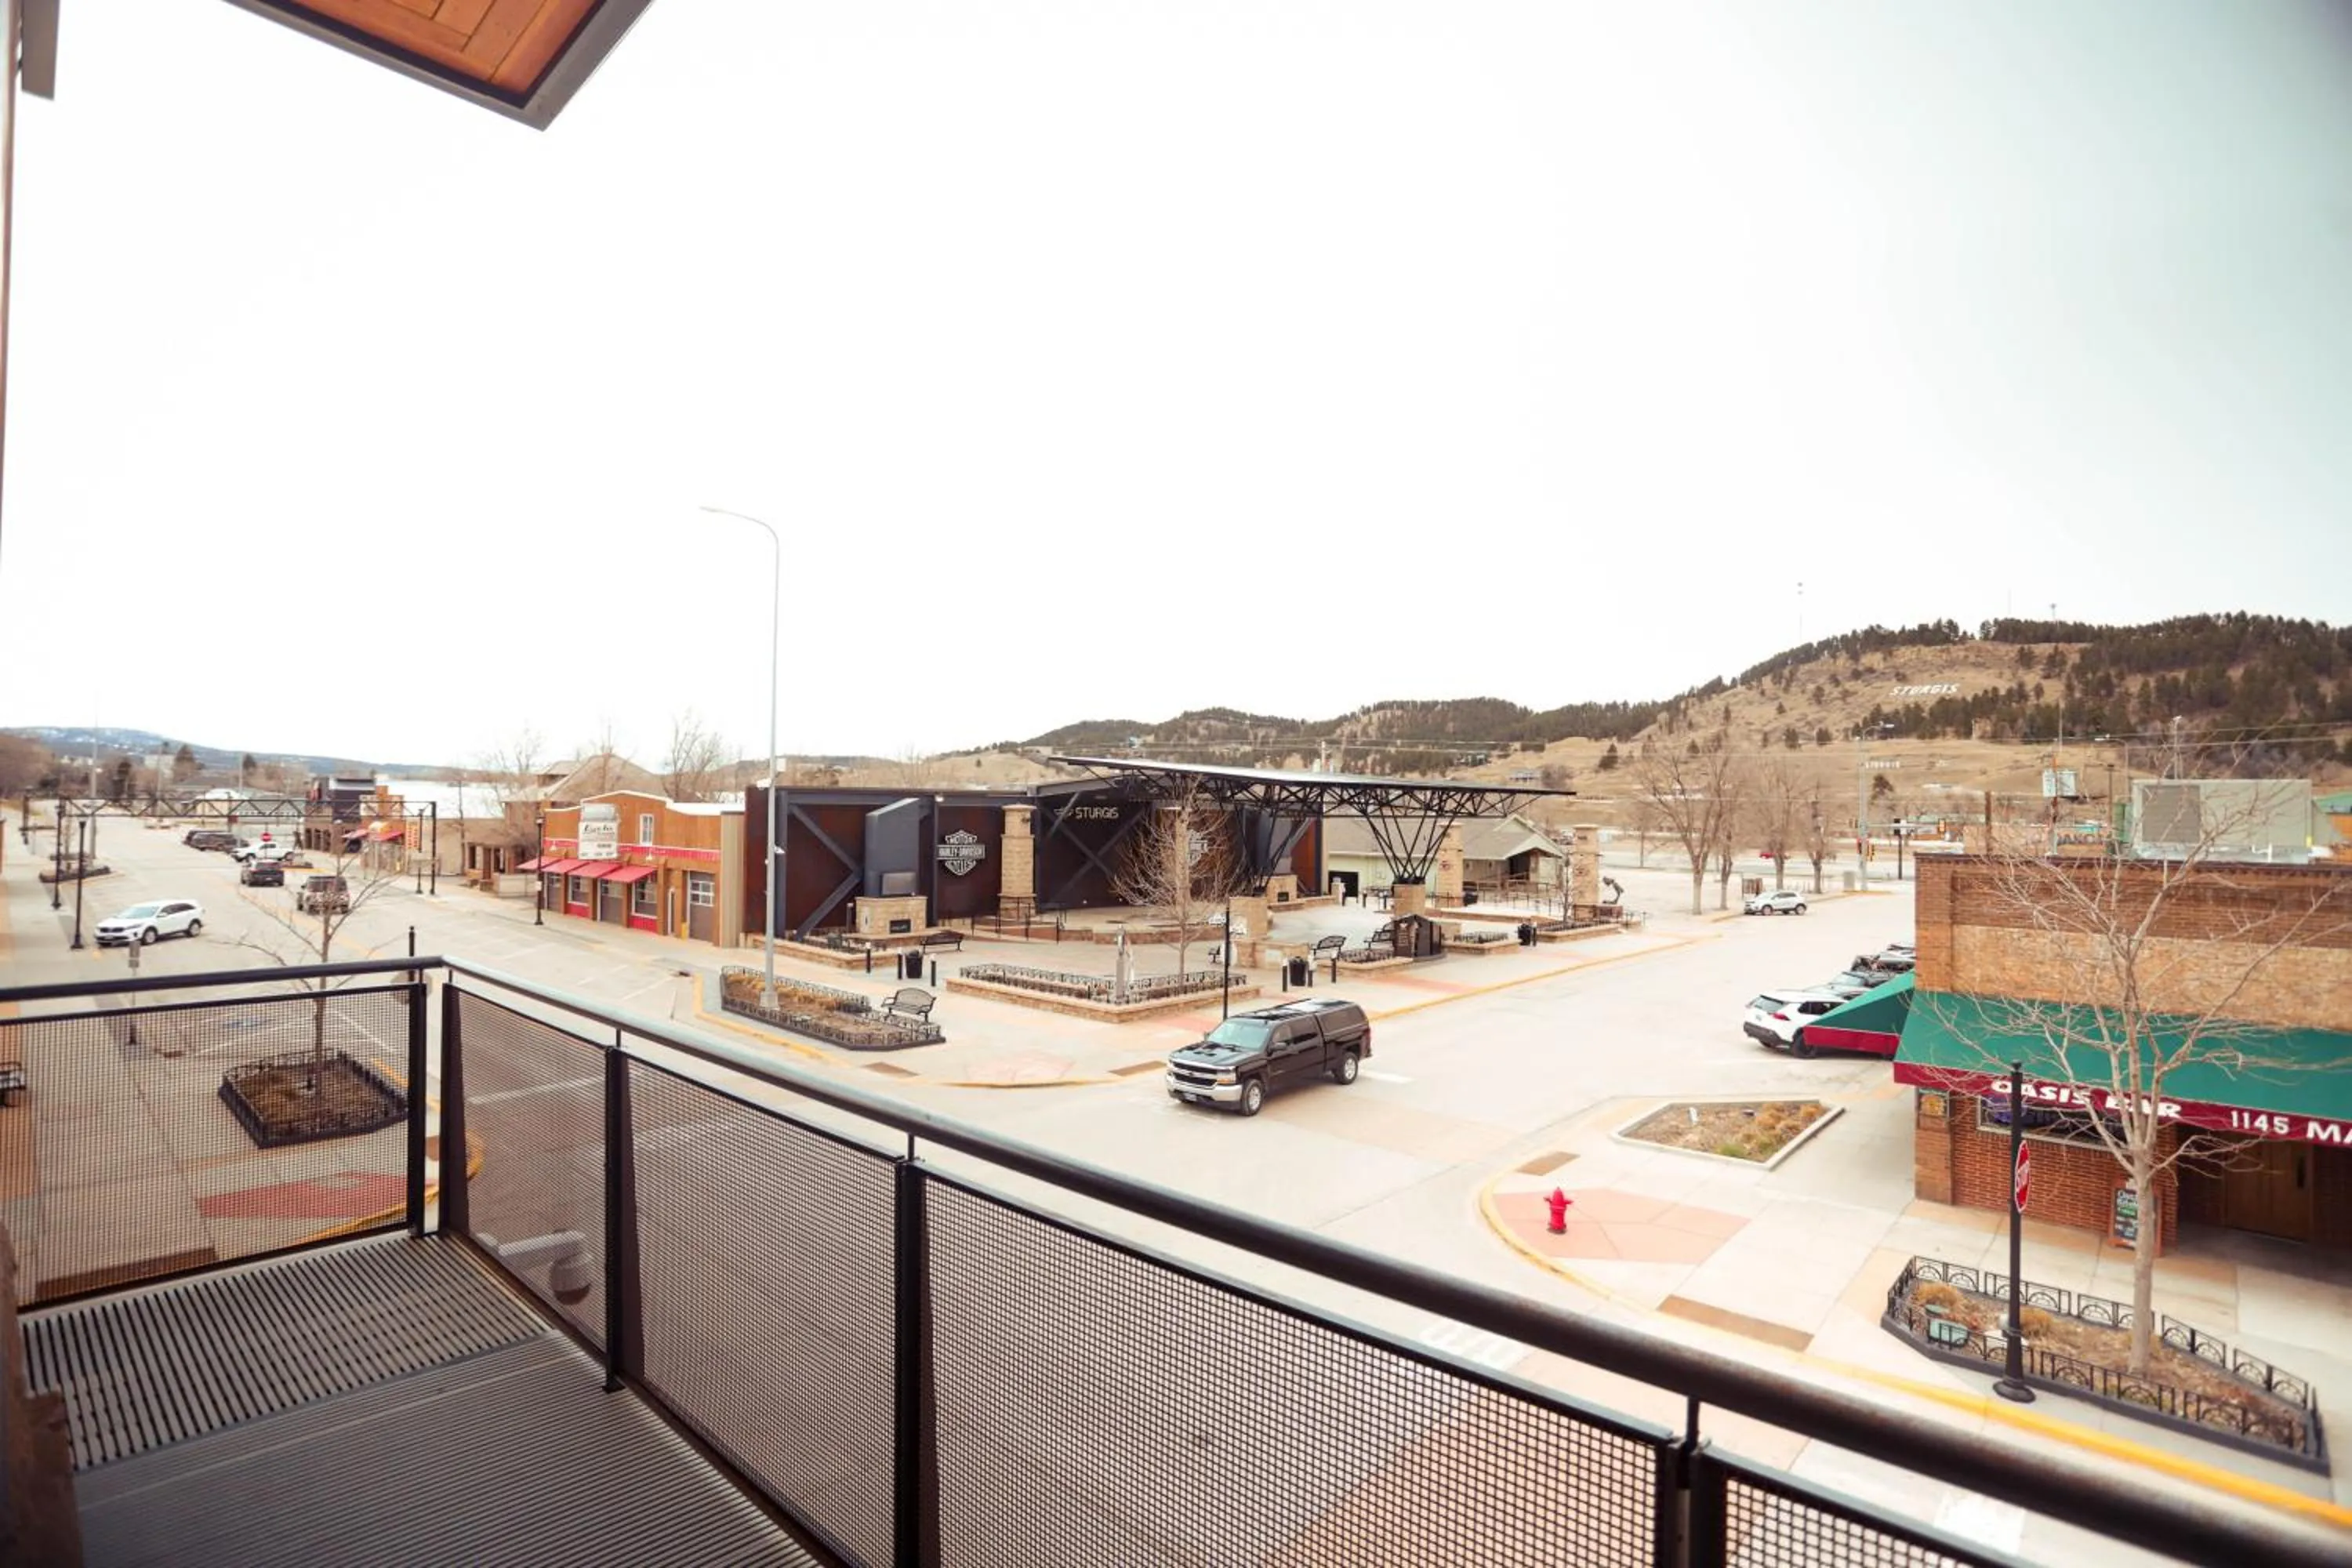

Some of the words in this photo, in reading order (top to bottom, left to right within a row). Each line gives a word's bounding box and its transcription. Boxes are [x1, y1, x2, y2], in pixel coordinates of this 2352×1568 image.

[1889, 683, 1960, 695] STURGIS
[1075, 807, 1119, 818] STURGIS
[1991, 1081, 2091, 1105] OASIS
[2230, 1110, 2289, 1134] 1145
